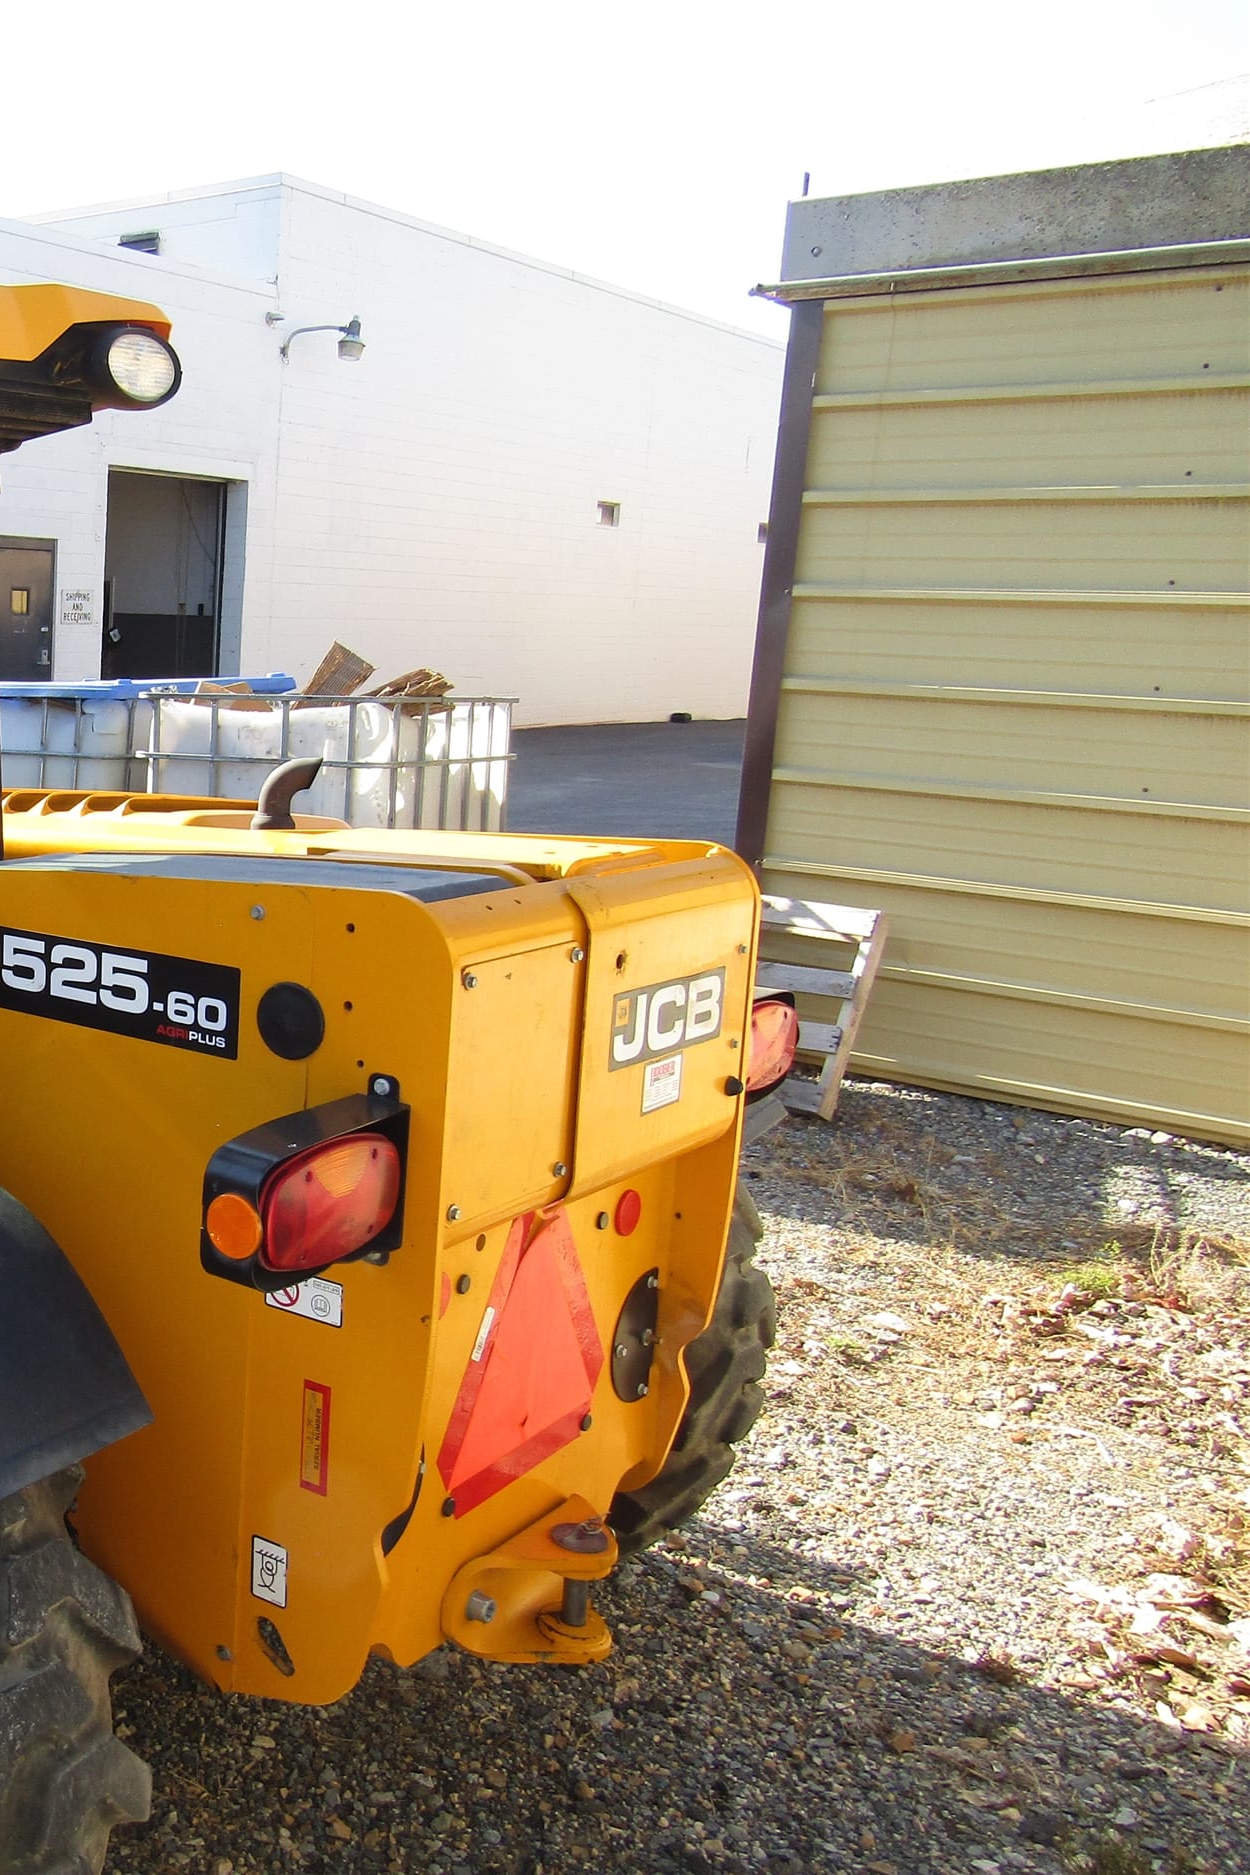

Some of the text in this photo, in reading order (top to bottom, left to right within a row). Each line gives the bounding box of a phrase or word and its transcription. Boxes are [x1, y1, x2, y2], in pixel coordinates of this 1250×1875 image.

[65, 592, 90, 602] SHIPPING
[71, 602, 84, 611] AND
[63, 612, 91, 622] RECEIVING
[1, 934, 227, 1031] 525-60
[612, 975, 721, 1062] JCB
